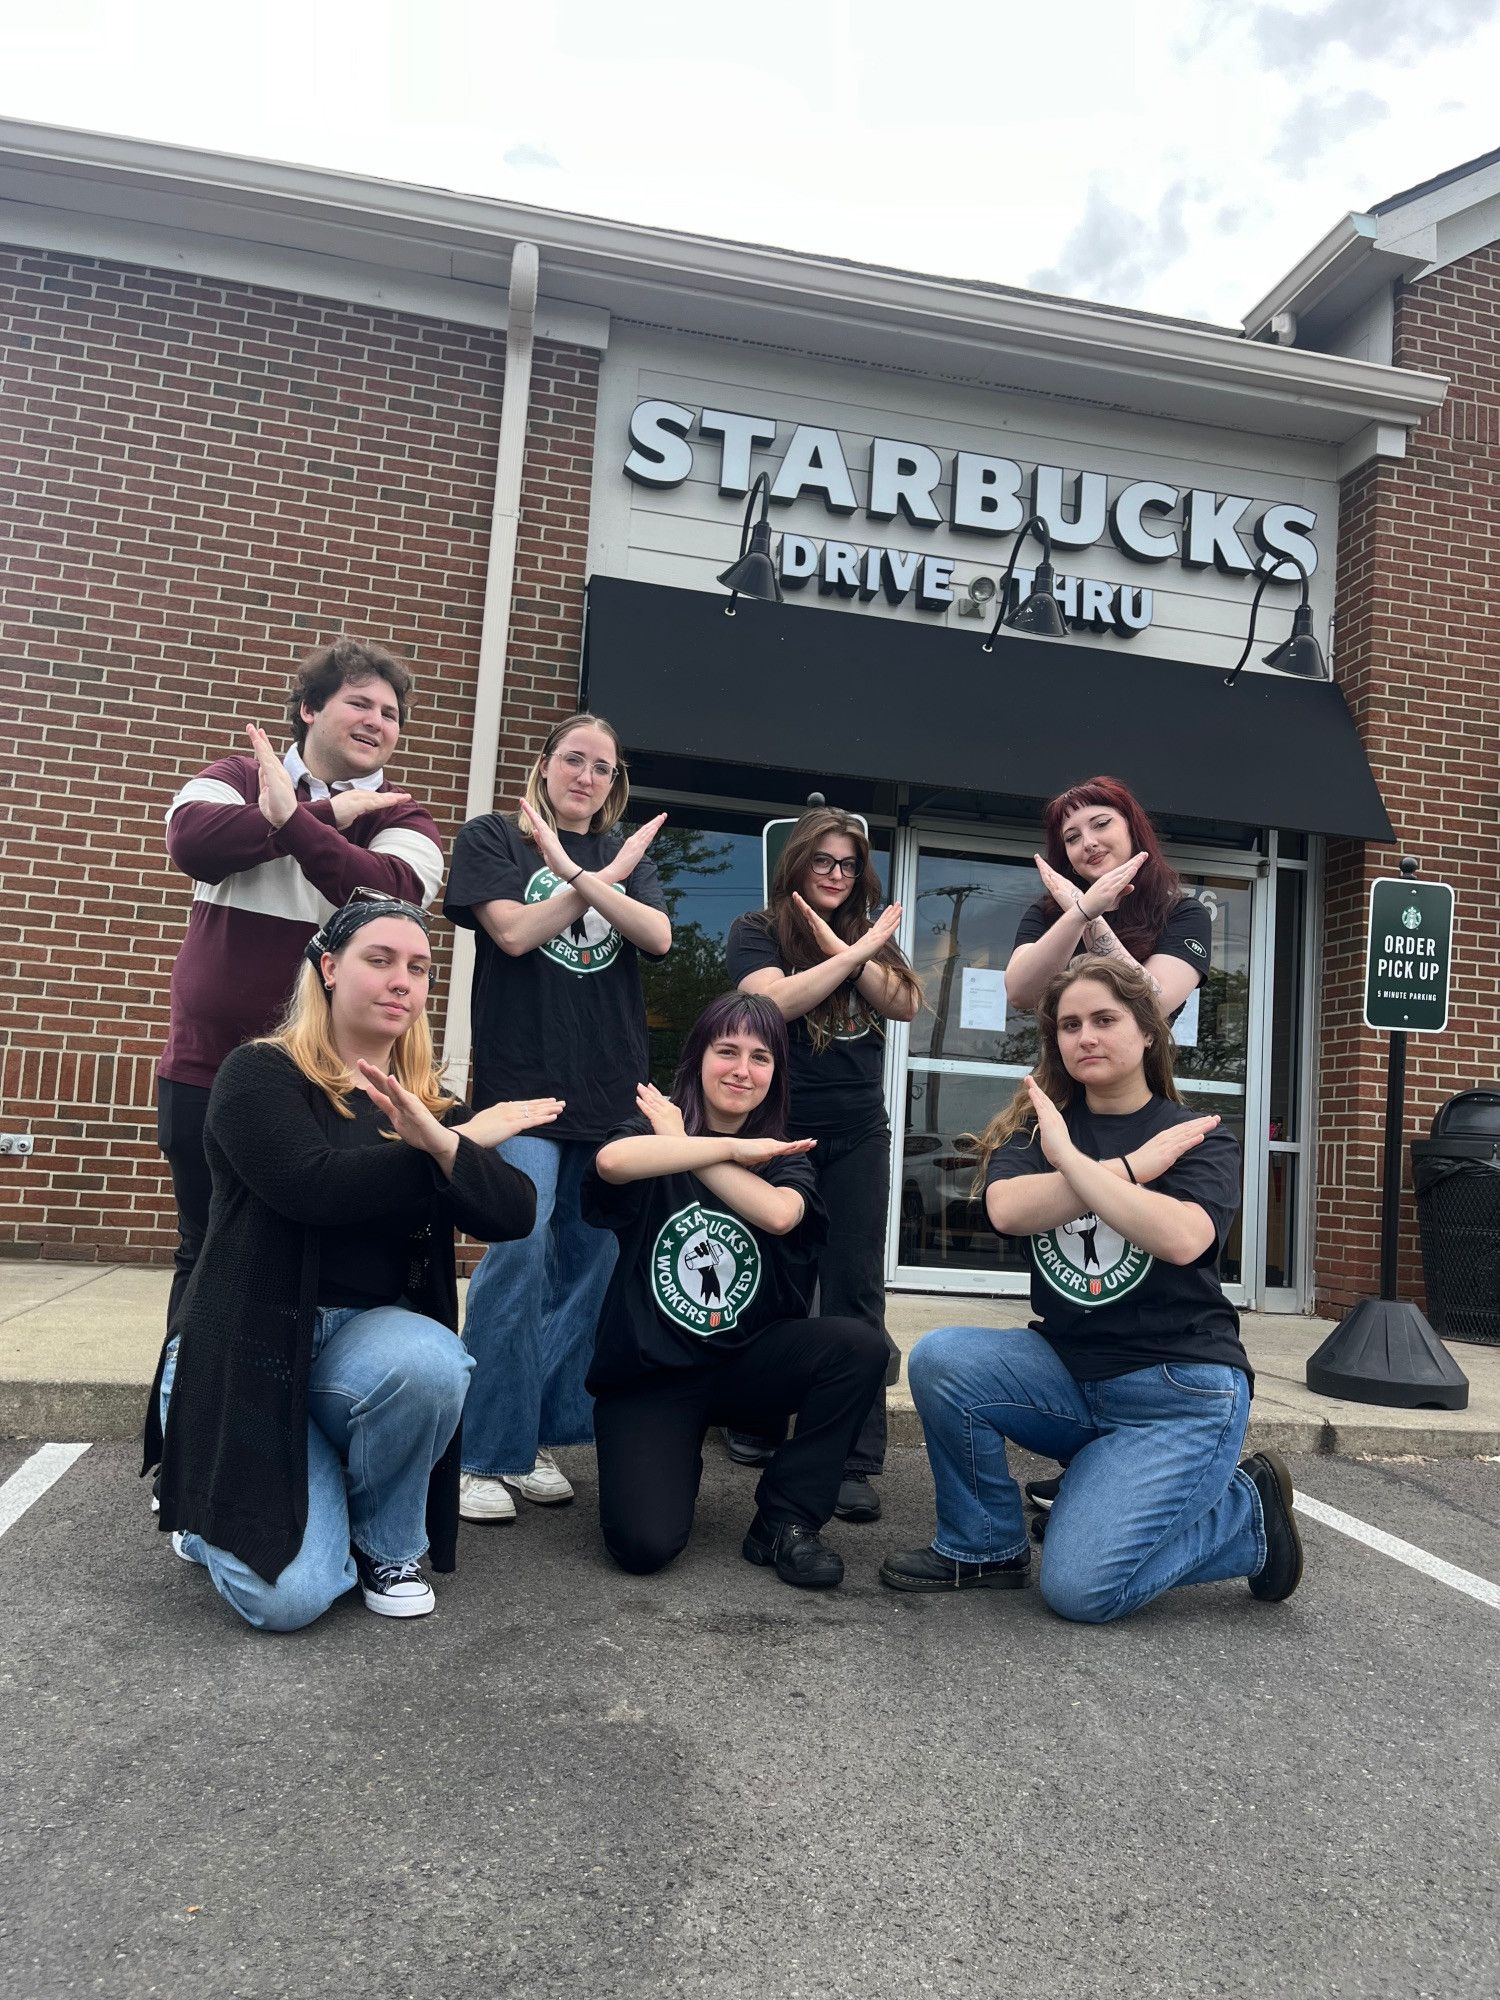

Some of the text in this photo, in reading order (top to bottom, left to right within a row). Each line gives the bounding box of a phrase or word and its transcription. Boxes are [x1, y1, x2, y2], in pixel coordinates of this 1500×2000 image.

[624, 400, 1318, 583] STARBUCKS
[779, 533, 955, 608] DRIVE
[1377, 958, 1440, 981] PICK UP
[1384, 935, 1436, 957] ORDER
[1377, 989, 1437, 1002] 5 MINUTE PARKING
[675, 1211, 749, 1254] STAUCKS
[1036, 1232, 1088, 1293] ORKERS
[1103, 1242, 1144, 1290] UNITE
[657, 1255, 708, 1325] WORKERS
